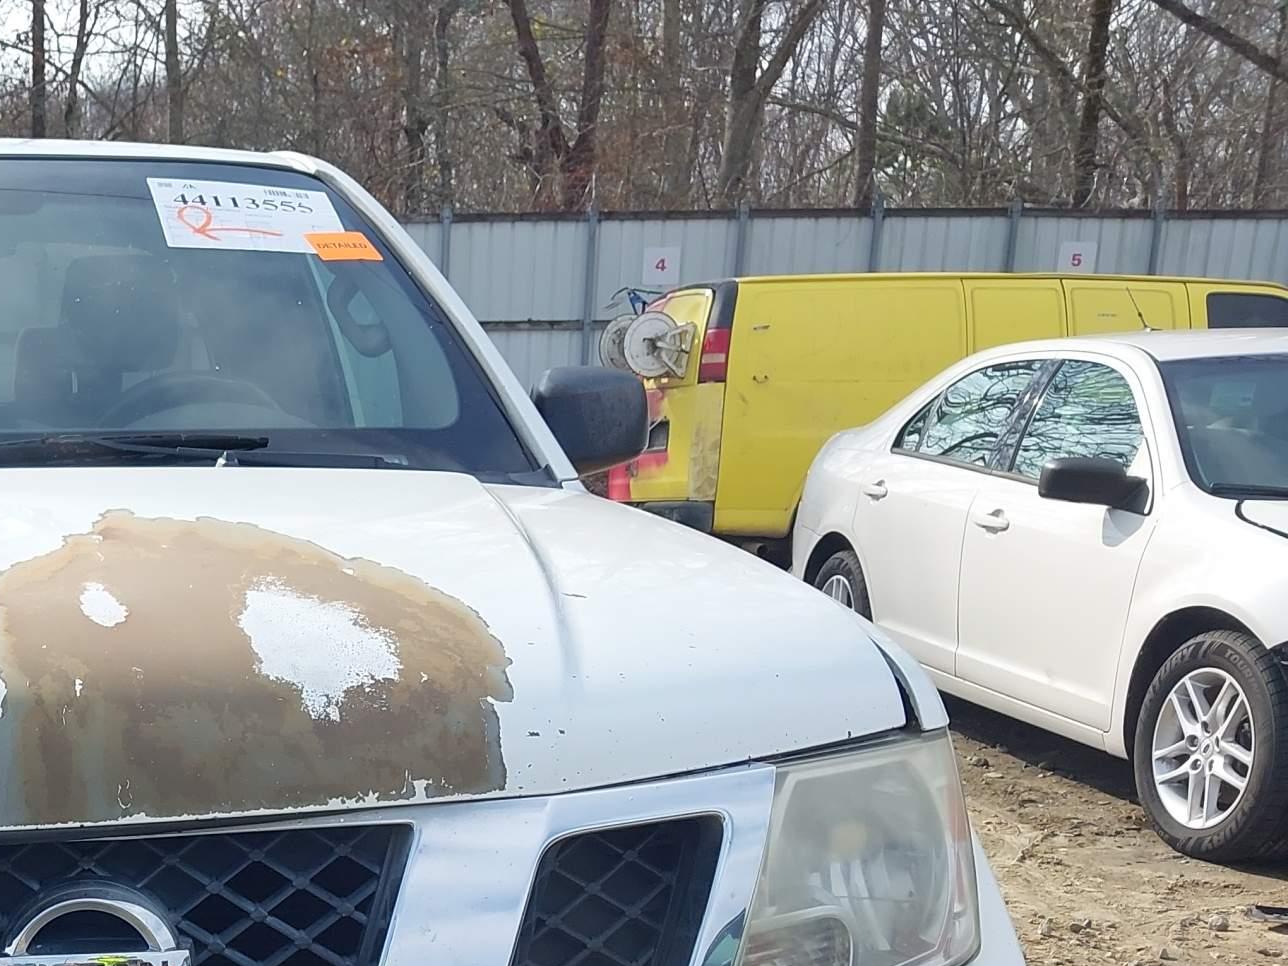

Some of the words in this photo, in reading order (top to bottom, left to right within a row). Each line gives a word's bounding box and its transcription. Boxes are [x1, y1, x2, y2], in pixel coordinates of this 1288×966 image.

[173, 193, 314, 214] 44113555
[655, 258, 667, 271] 4
[1071, 253, 1082, 267] 5
